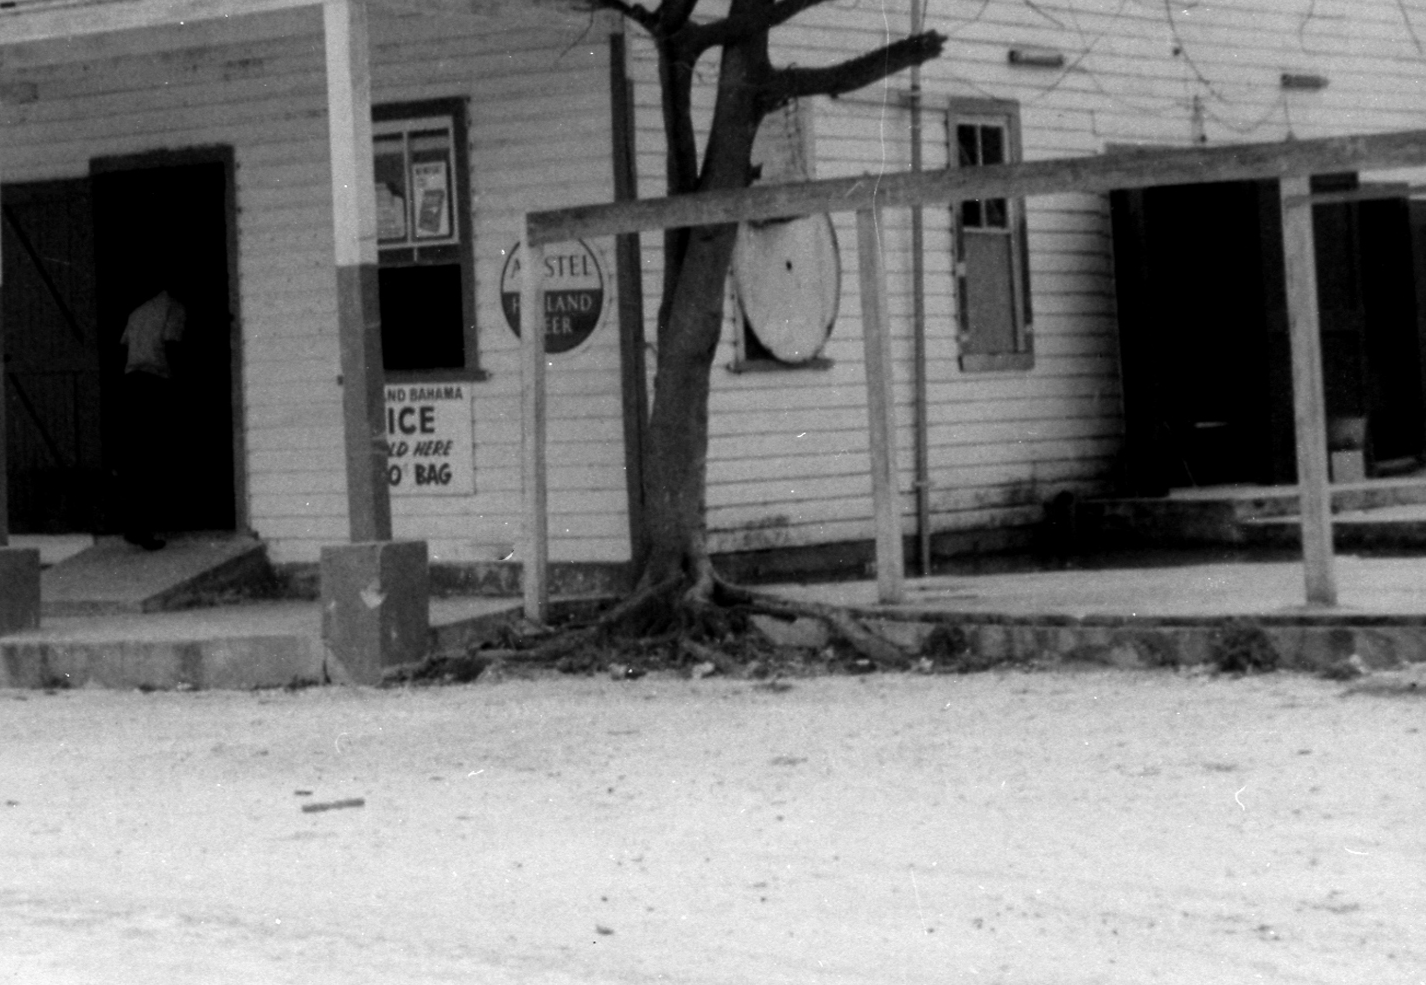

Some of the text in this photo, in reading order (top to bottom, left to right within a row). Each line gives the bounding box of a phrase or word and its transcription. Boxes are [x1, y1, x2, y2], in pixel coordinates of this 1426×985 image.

[510, 254, 593, 279] ASTEL
[512, 292, 592, 315] HLAND
[409, 386, 464, 402] BAHAMA
[388, 406, 436, 435] ICE
[412, 439, 454, 458] HERE
[414, 462, 453, 487] BAG
